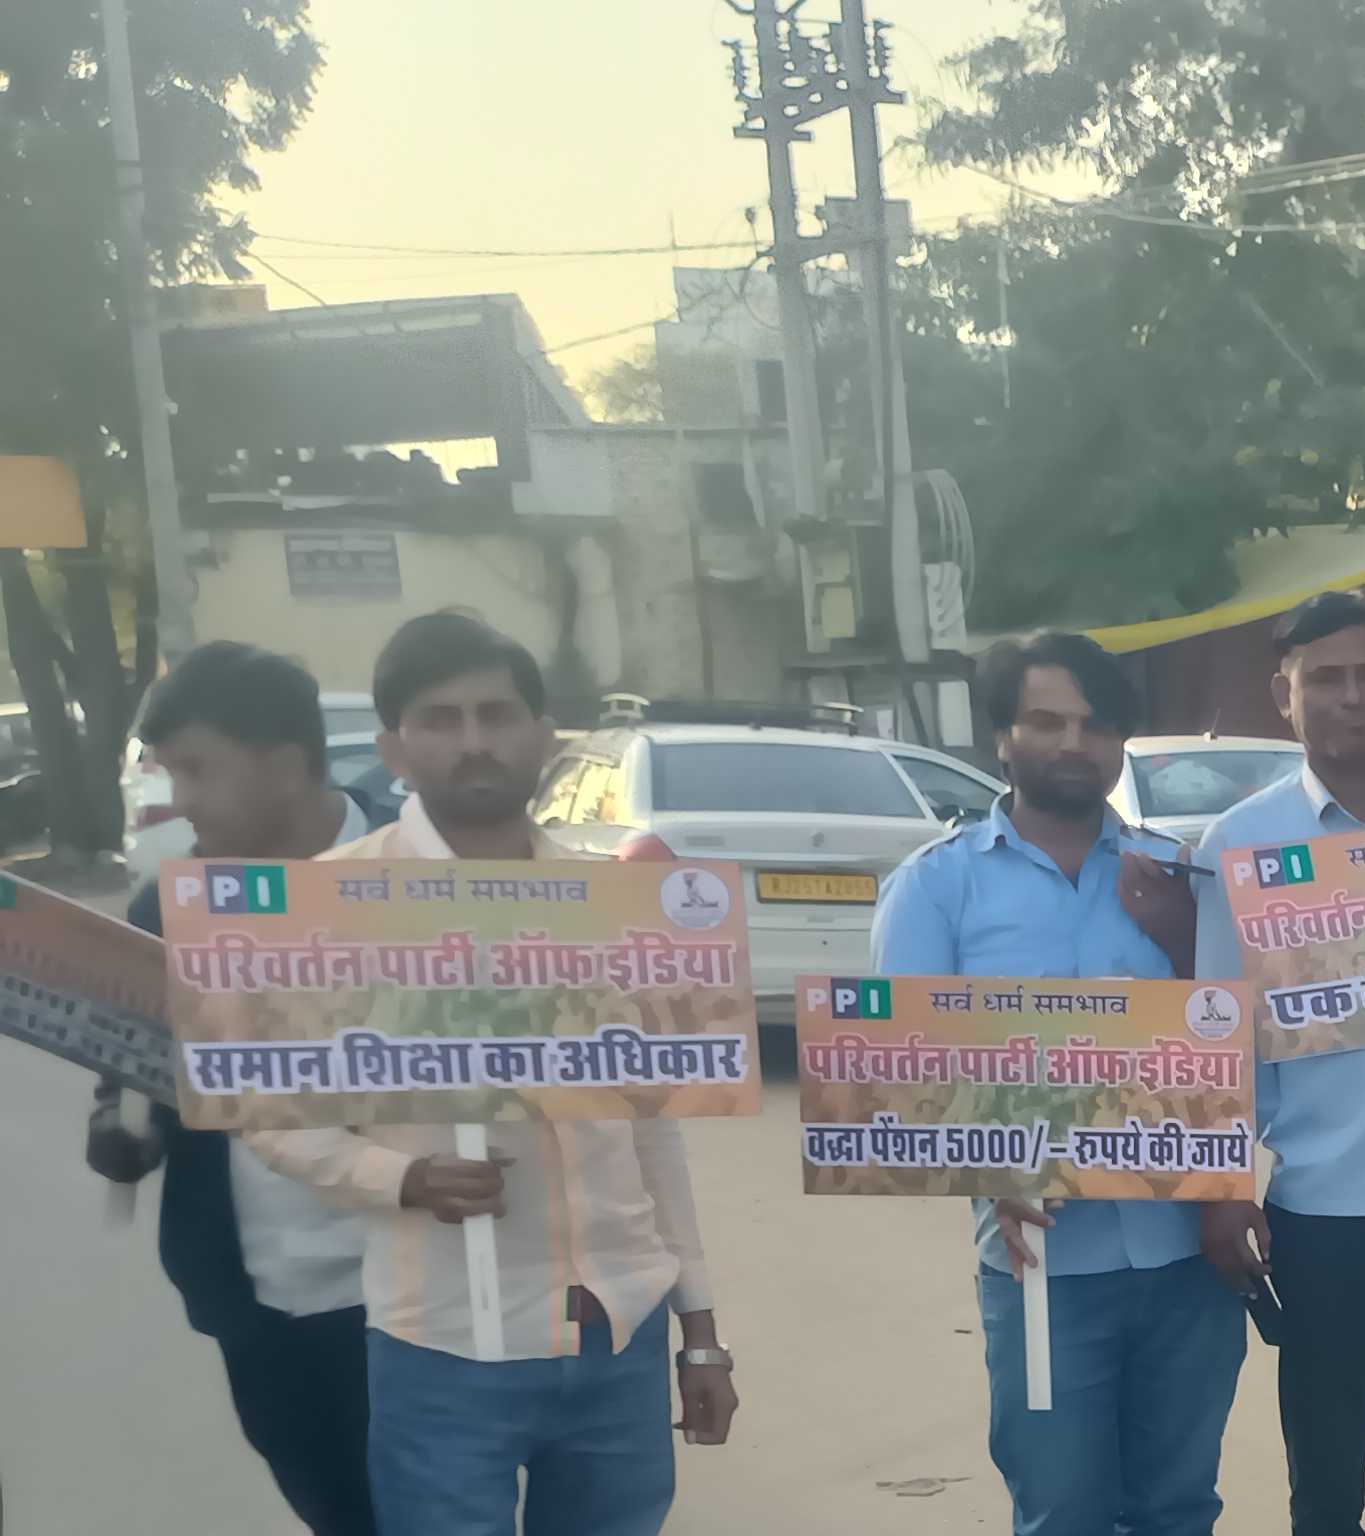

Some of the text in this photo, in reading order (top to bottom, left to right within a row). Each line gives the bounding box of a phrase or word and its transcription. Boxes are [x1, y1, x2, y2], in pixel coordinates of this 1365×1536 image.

[1234, 851, 1302, 885] PPI
[175, 876, 271, 908] PPI
[178, 931, 732, 993] परिवर्तन पार्टी ऑफ इंडिया
[807, 987, 880, 1015] PPI
[930, 984, 1128, 1016] सर्व धर्म समभाव
[1270, 984, 1352, 1025] एक
[194, 1029, 742, 1089] समान शिक्षा का अधिकार
[808, 1034, 1239, 1093] परिवर्तन पार्टी ऑफ इंडिया
[870, 1116, 939, 1162] पेंशन
[1148, 1123, 1185, 1166] की
[1190, 1123, 1248, 1167] जाये
